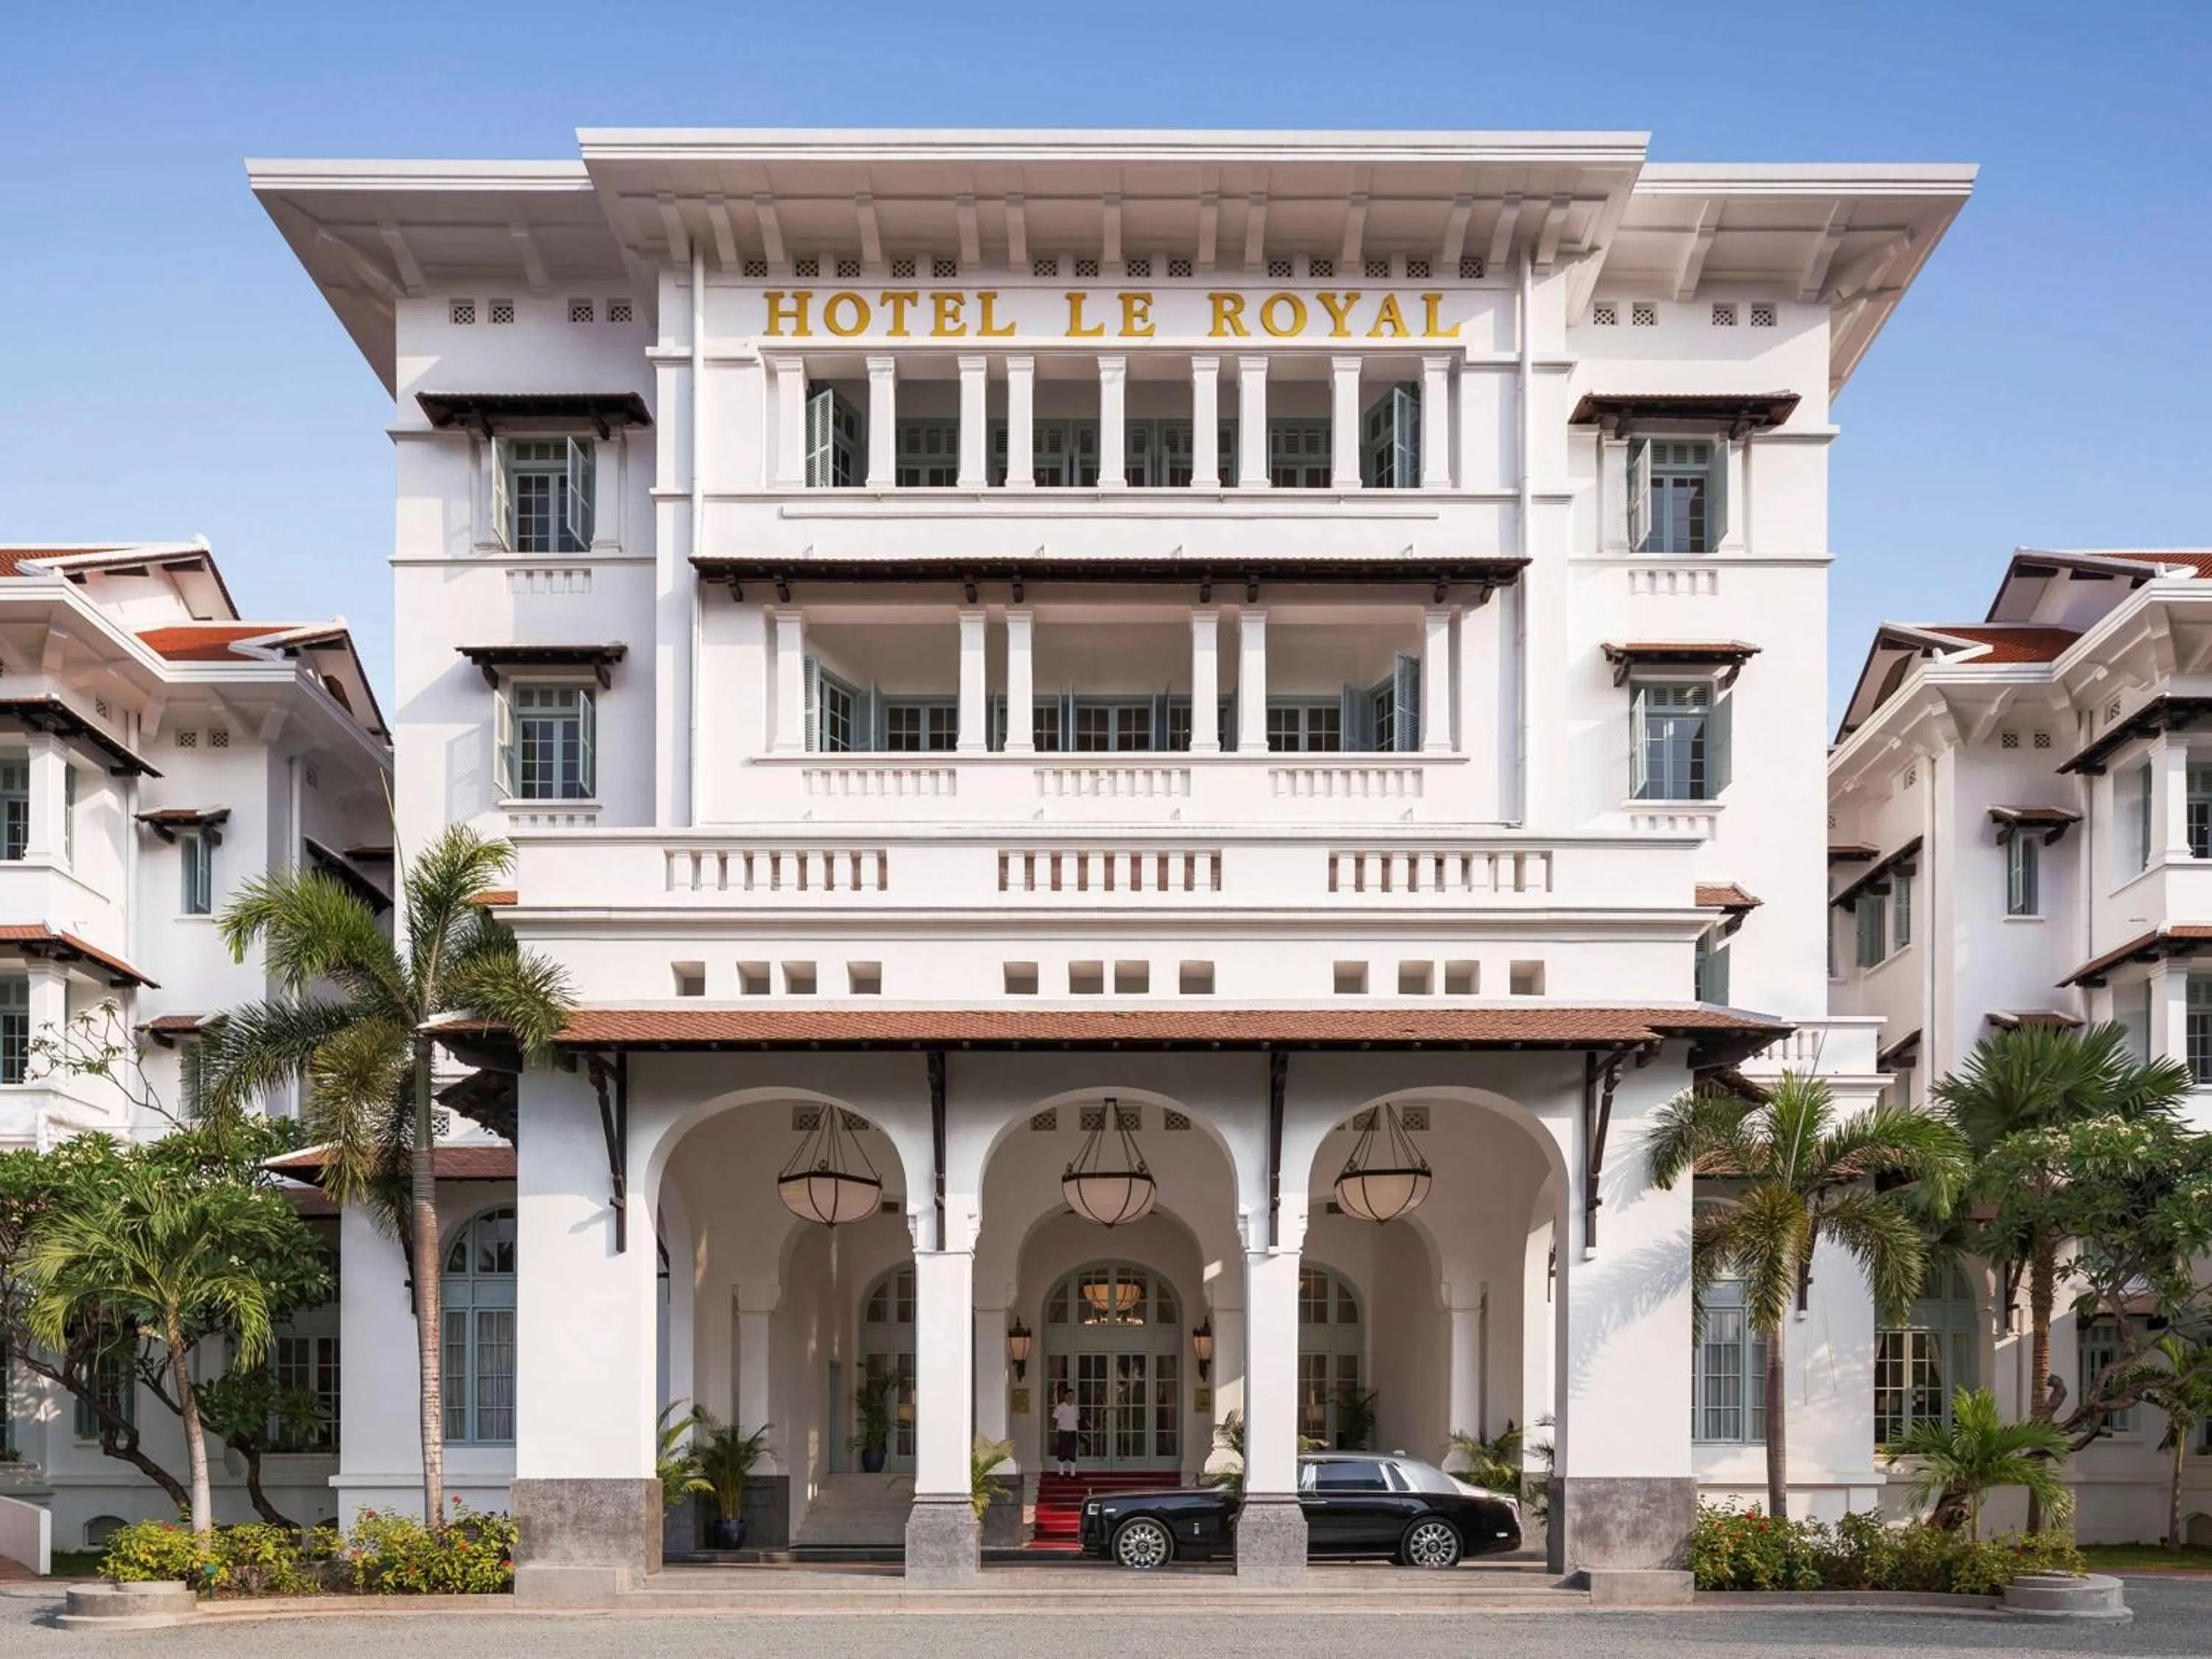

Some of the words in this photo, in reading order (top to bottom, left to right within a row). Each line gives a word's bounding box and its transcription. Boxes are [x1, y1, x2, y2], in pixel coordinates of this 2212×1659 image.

[763, 291, 1015, 337] HOTEL
[1064, 292, 1155, 337] LE
[1207, 292, 1460, 338] ROYAL
